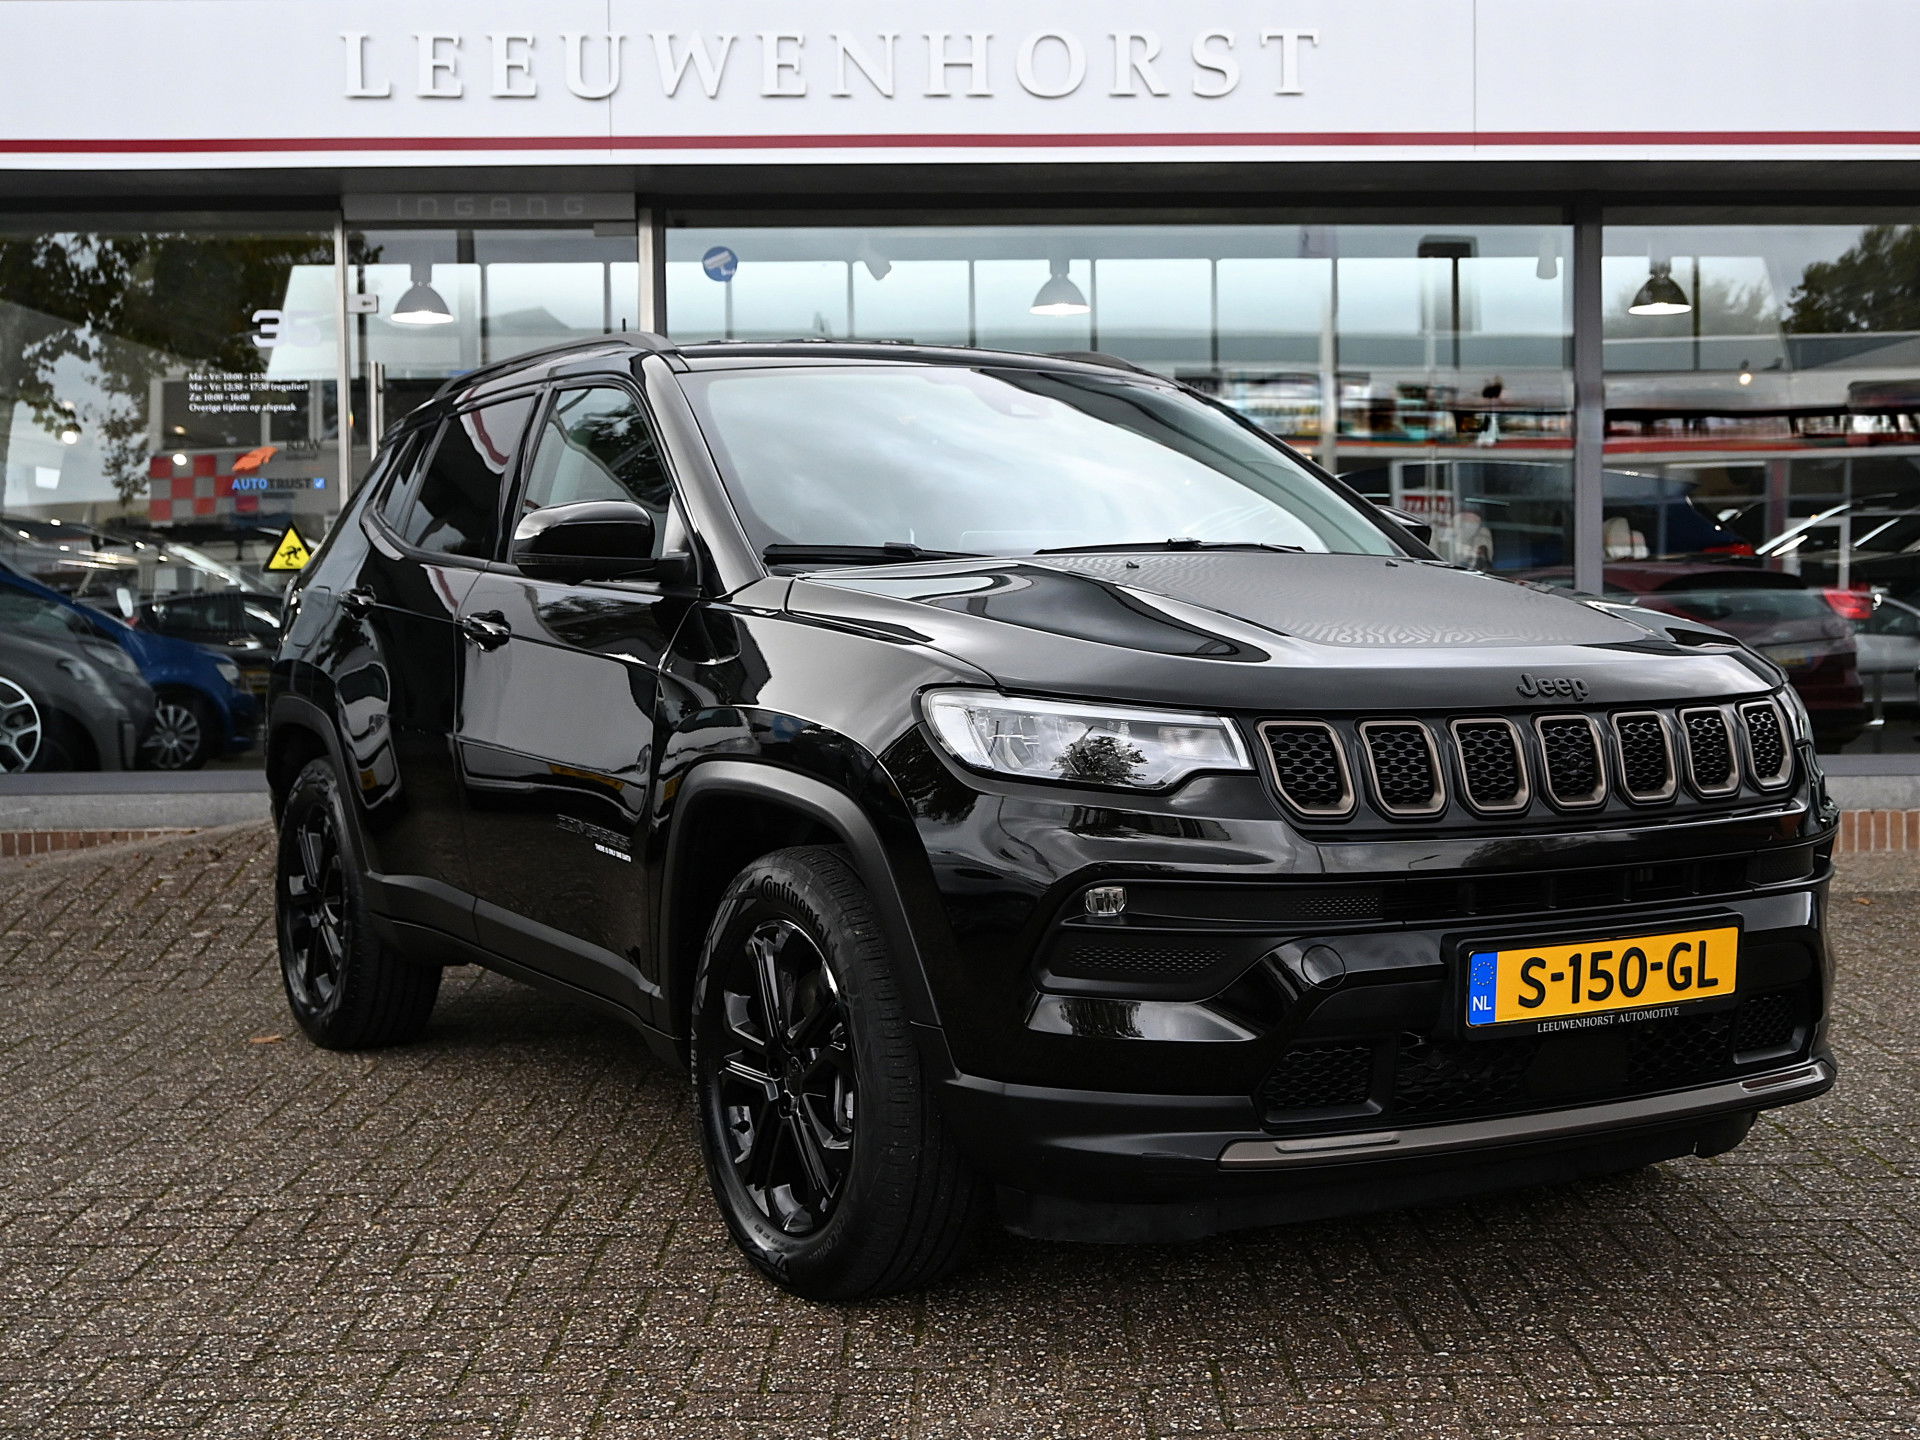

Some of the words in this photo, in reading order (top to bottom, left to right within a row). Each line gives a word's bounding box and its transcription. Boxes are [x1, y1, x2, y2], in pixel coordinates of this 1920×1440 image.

[339, 29, 1321, 100] LEEUWENHORST
[232, 478, 311, 490] AUTOTRUST
[1516, 672, 1590, 702] Jeep
[1518, 940, 1719, 1009] S-150-GL
[1472, 996, 1492, 1011] NL
[1537, 1014, 1614, 1033] LEEUWENHORST
[1618, 1006, 1680, 1024] AUTOMOTIVE
